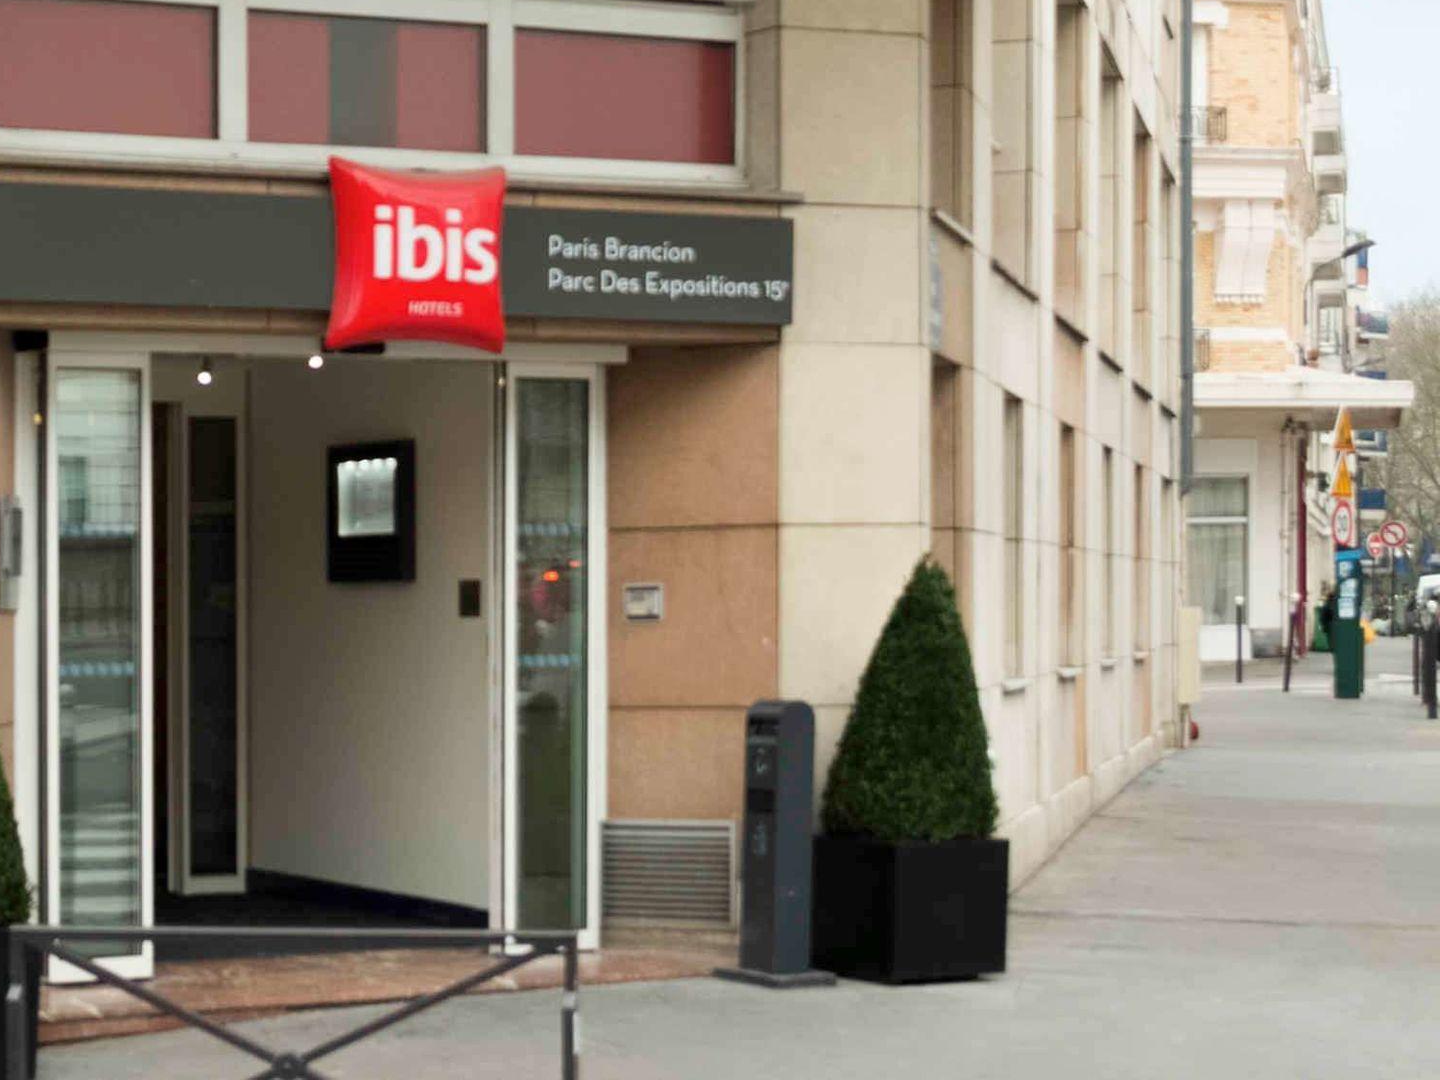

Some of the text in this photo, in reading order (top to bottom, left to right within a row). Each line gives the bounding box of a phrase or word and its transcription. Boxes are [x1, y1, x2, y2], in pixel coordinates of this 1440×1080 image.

[373, 204, 497, 284] ibis
[548, 234, 695, 262] Paris Brancion
[548, 266, 595, 291] Parc
[600, 269, 640, 293] Des
[645, 270, 760, 300] Expositions
[408, 300, 463, 317] HOTELS
